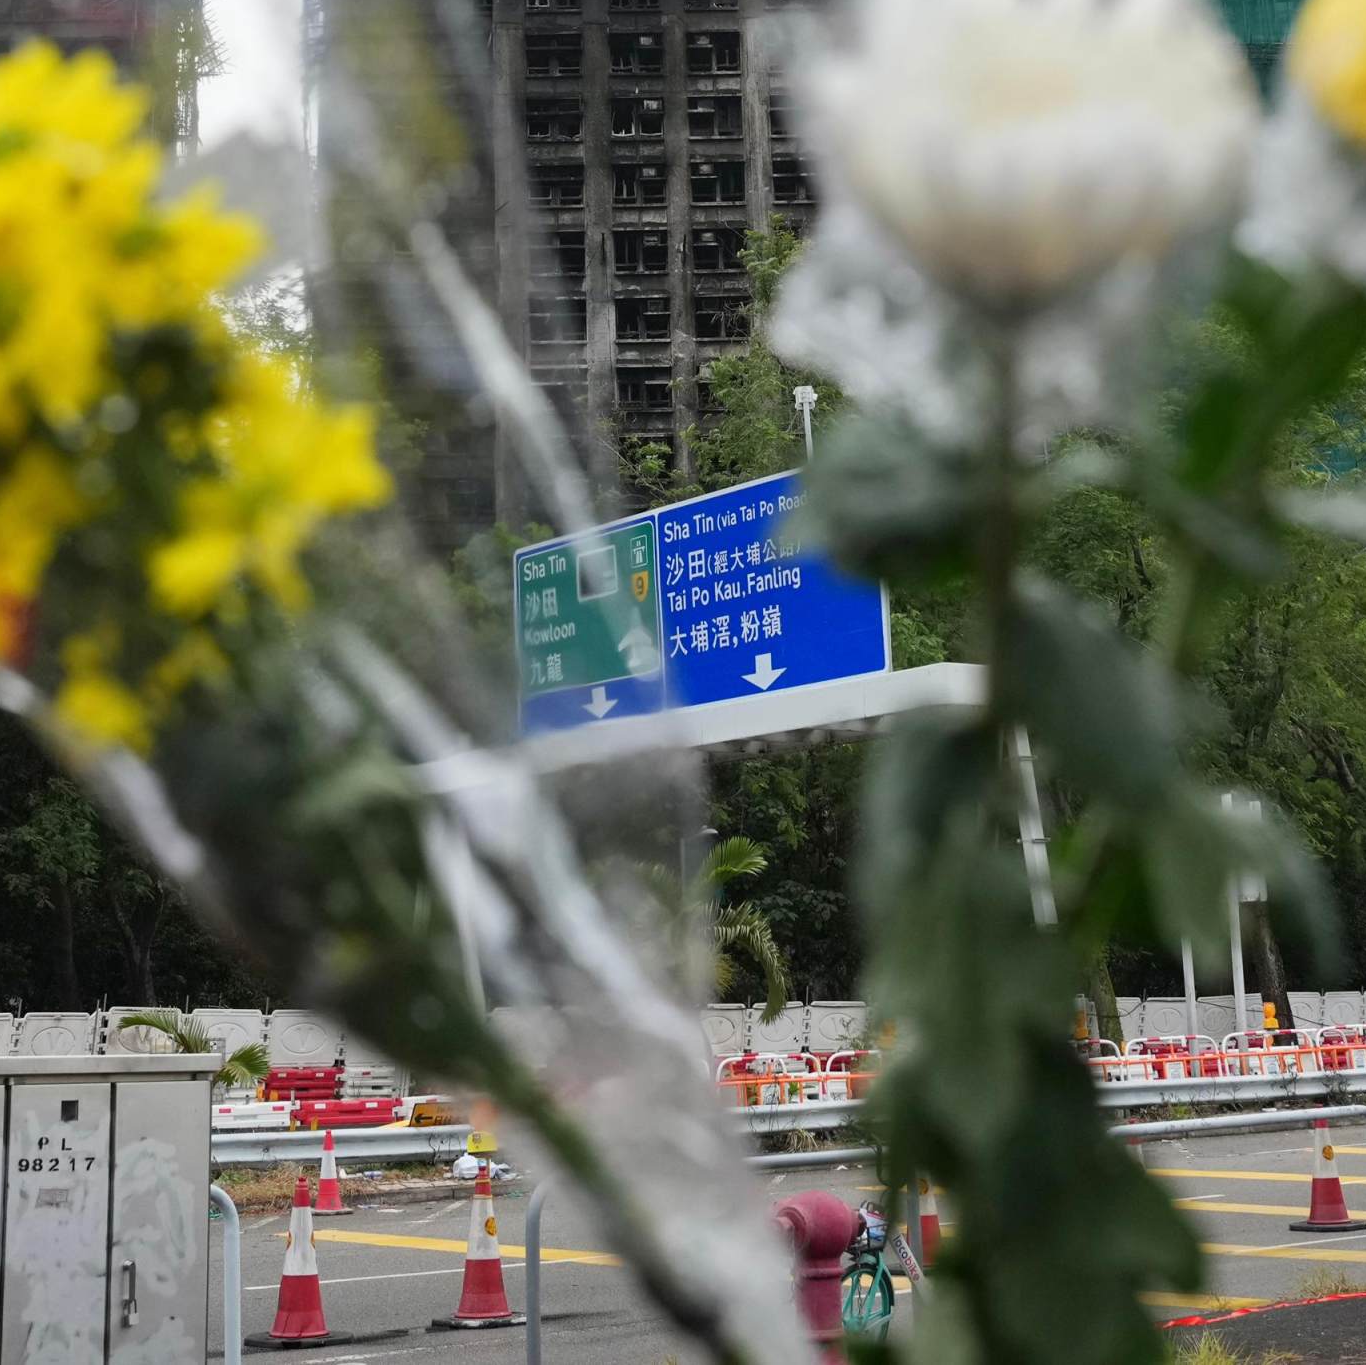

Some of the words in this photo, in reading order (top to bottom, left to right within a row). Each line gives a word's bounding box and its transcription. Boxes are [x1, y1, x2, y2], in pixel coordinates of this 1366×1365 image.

[664, 521, 690, 543] Sha
[693, 513, 714, 535] Tin
[717, 511, 737, 531] (via
[740, 503, 756, 523] Tai
[760, 501, 774, 517] Po
[523, 562, 546, 582] Sha
[548, 554, 567, 575] Tin
[635, 576, 645, 595] 9
[667, 590, 686, 613] Tai
[692, 587, 709, 608] Po
[747, 566, 801, 594] Fanling
[525, 587, 559, 622] 沙田
[524, 621, 576, 646] Kowloon
[530, 653, 564, 685] 九龍
[18, 1157, 95, 1172] 98217
[893, 1234, 921, 1283] locobike
